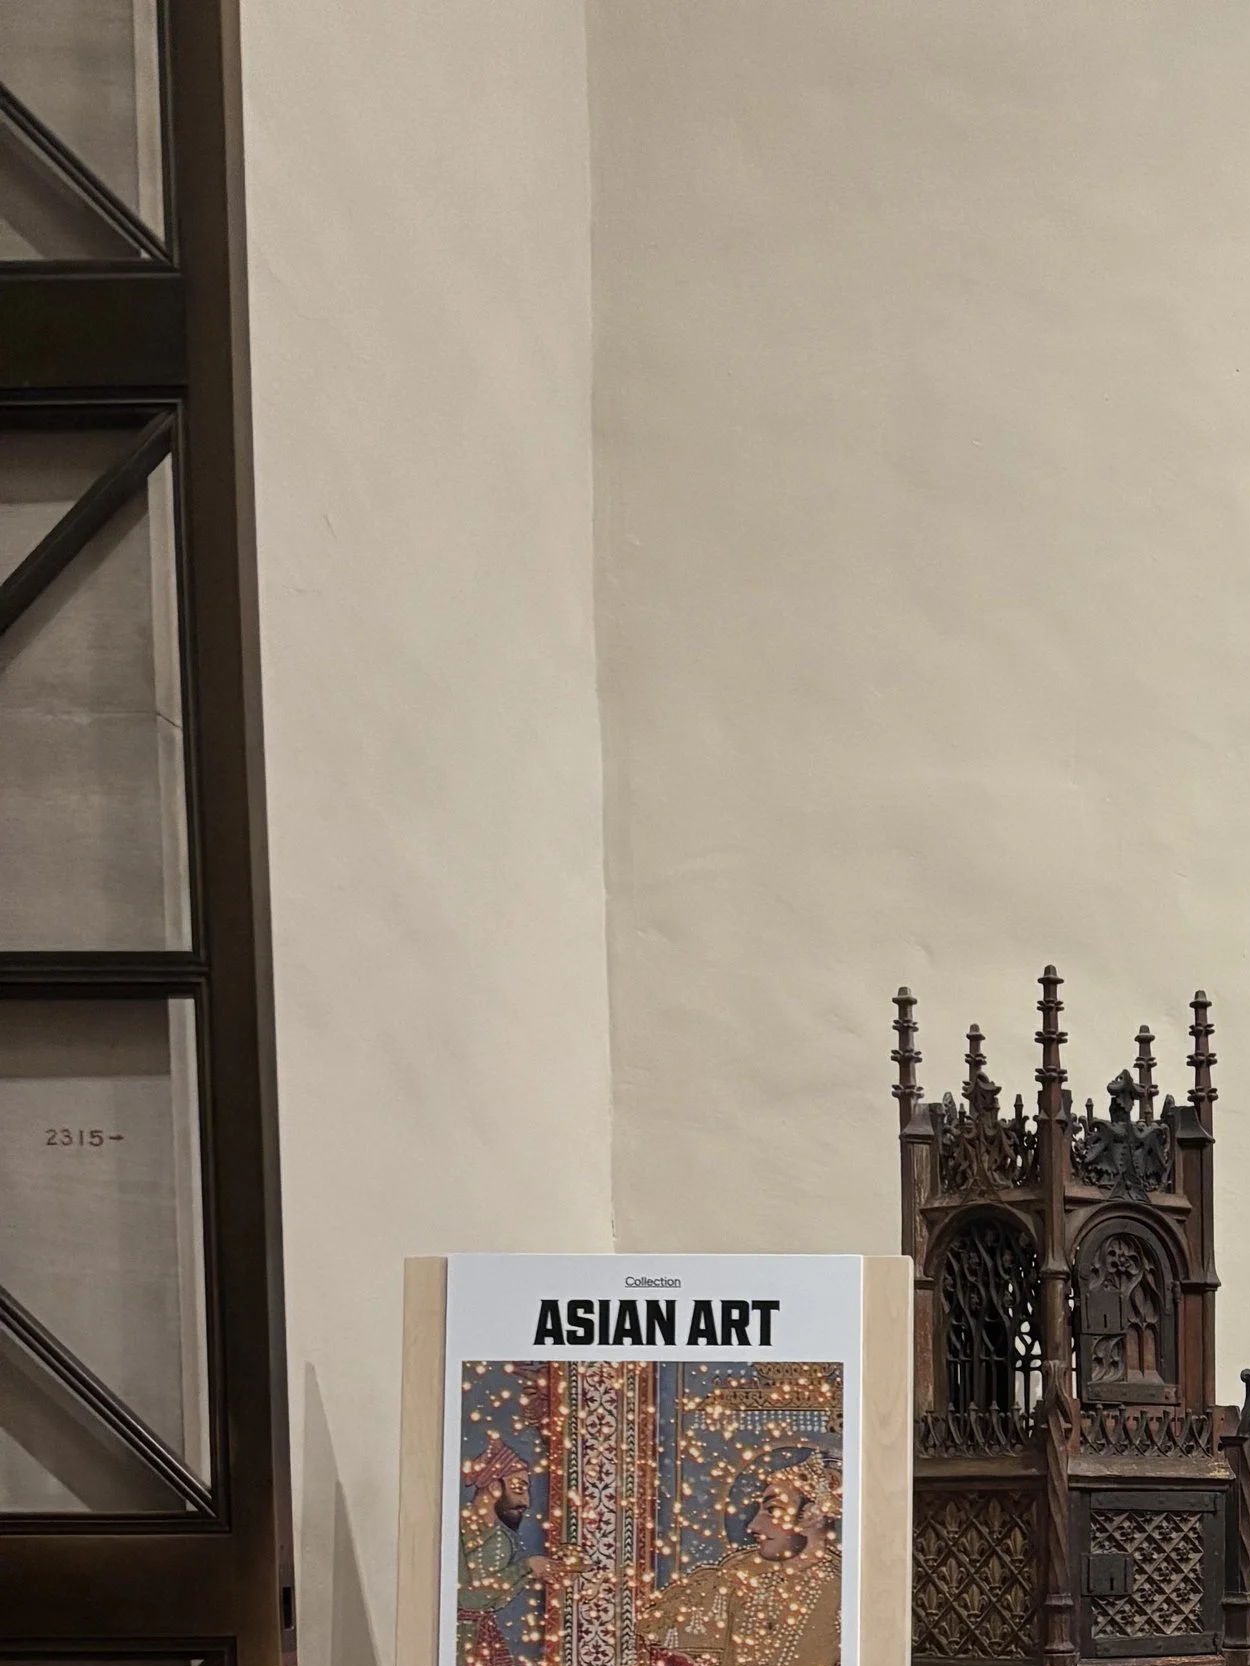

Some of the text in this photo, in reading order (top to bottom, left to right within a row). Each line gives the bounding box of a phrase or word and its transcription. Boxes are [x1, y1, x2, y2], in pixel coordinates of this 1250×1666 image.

[45, 1129, 104, 1147] 2315
[624, 1276, 682, 1288] Collection
[533, 1299, 781, 1346] ASIAN ART
